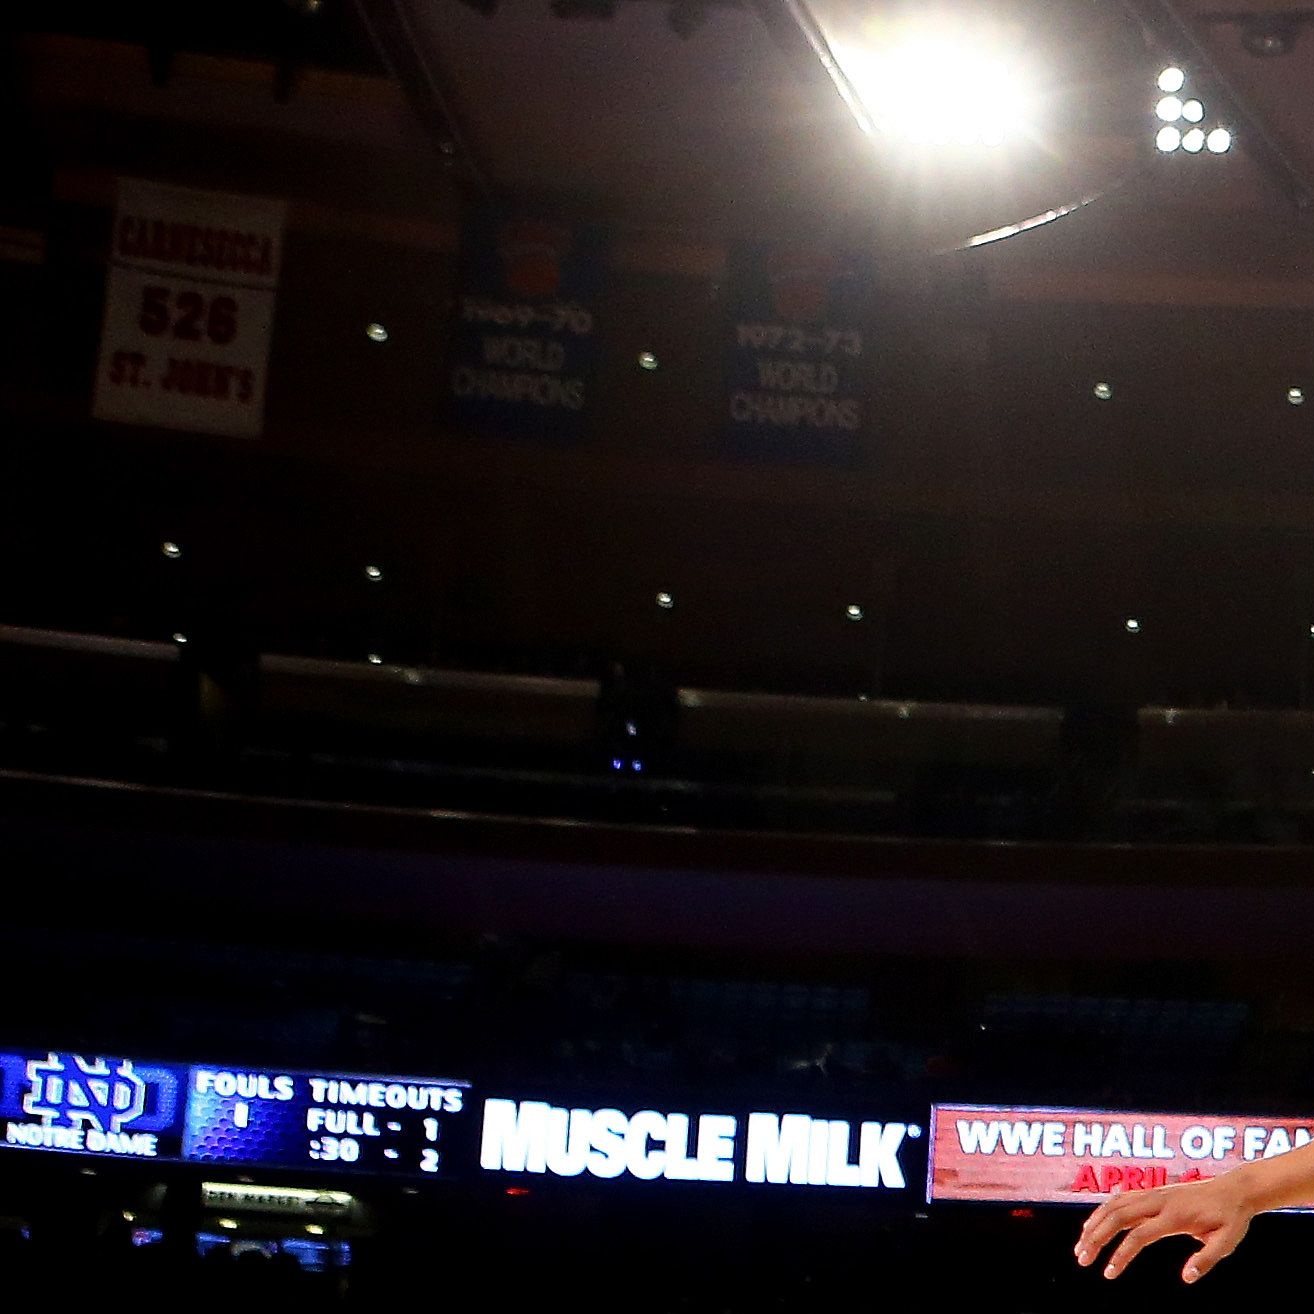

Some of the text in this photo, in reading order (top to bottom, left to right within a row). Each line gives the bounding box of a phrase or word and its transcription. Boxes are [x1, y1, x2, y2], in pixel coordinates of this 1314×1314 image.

[139, 285, 238, 345] 526
[483, 336, 565, 371] WORLD
[757, 361, 838, 394] WORLD
[195, 1070, 294, 1101] FOULS
[308, 1077, 464, 1113] TIMEOUTS
[6, 1122, 158, 1157] NOTRE DAME
[307, 1108, 380, 1137] FULL
[423, 1117, 439, 1142] 1
[956, 1119, 1065, 1156] WWE
[1072, 1121, 1175, 1160] HALL
[1180, 1124, 1236, 1161] OF
[309, 1136, 360, 1162] :30
[420, 1148, 439, 1173] 2
[480, 1098, 907, 1189] MUSCLE MILK
